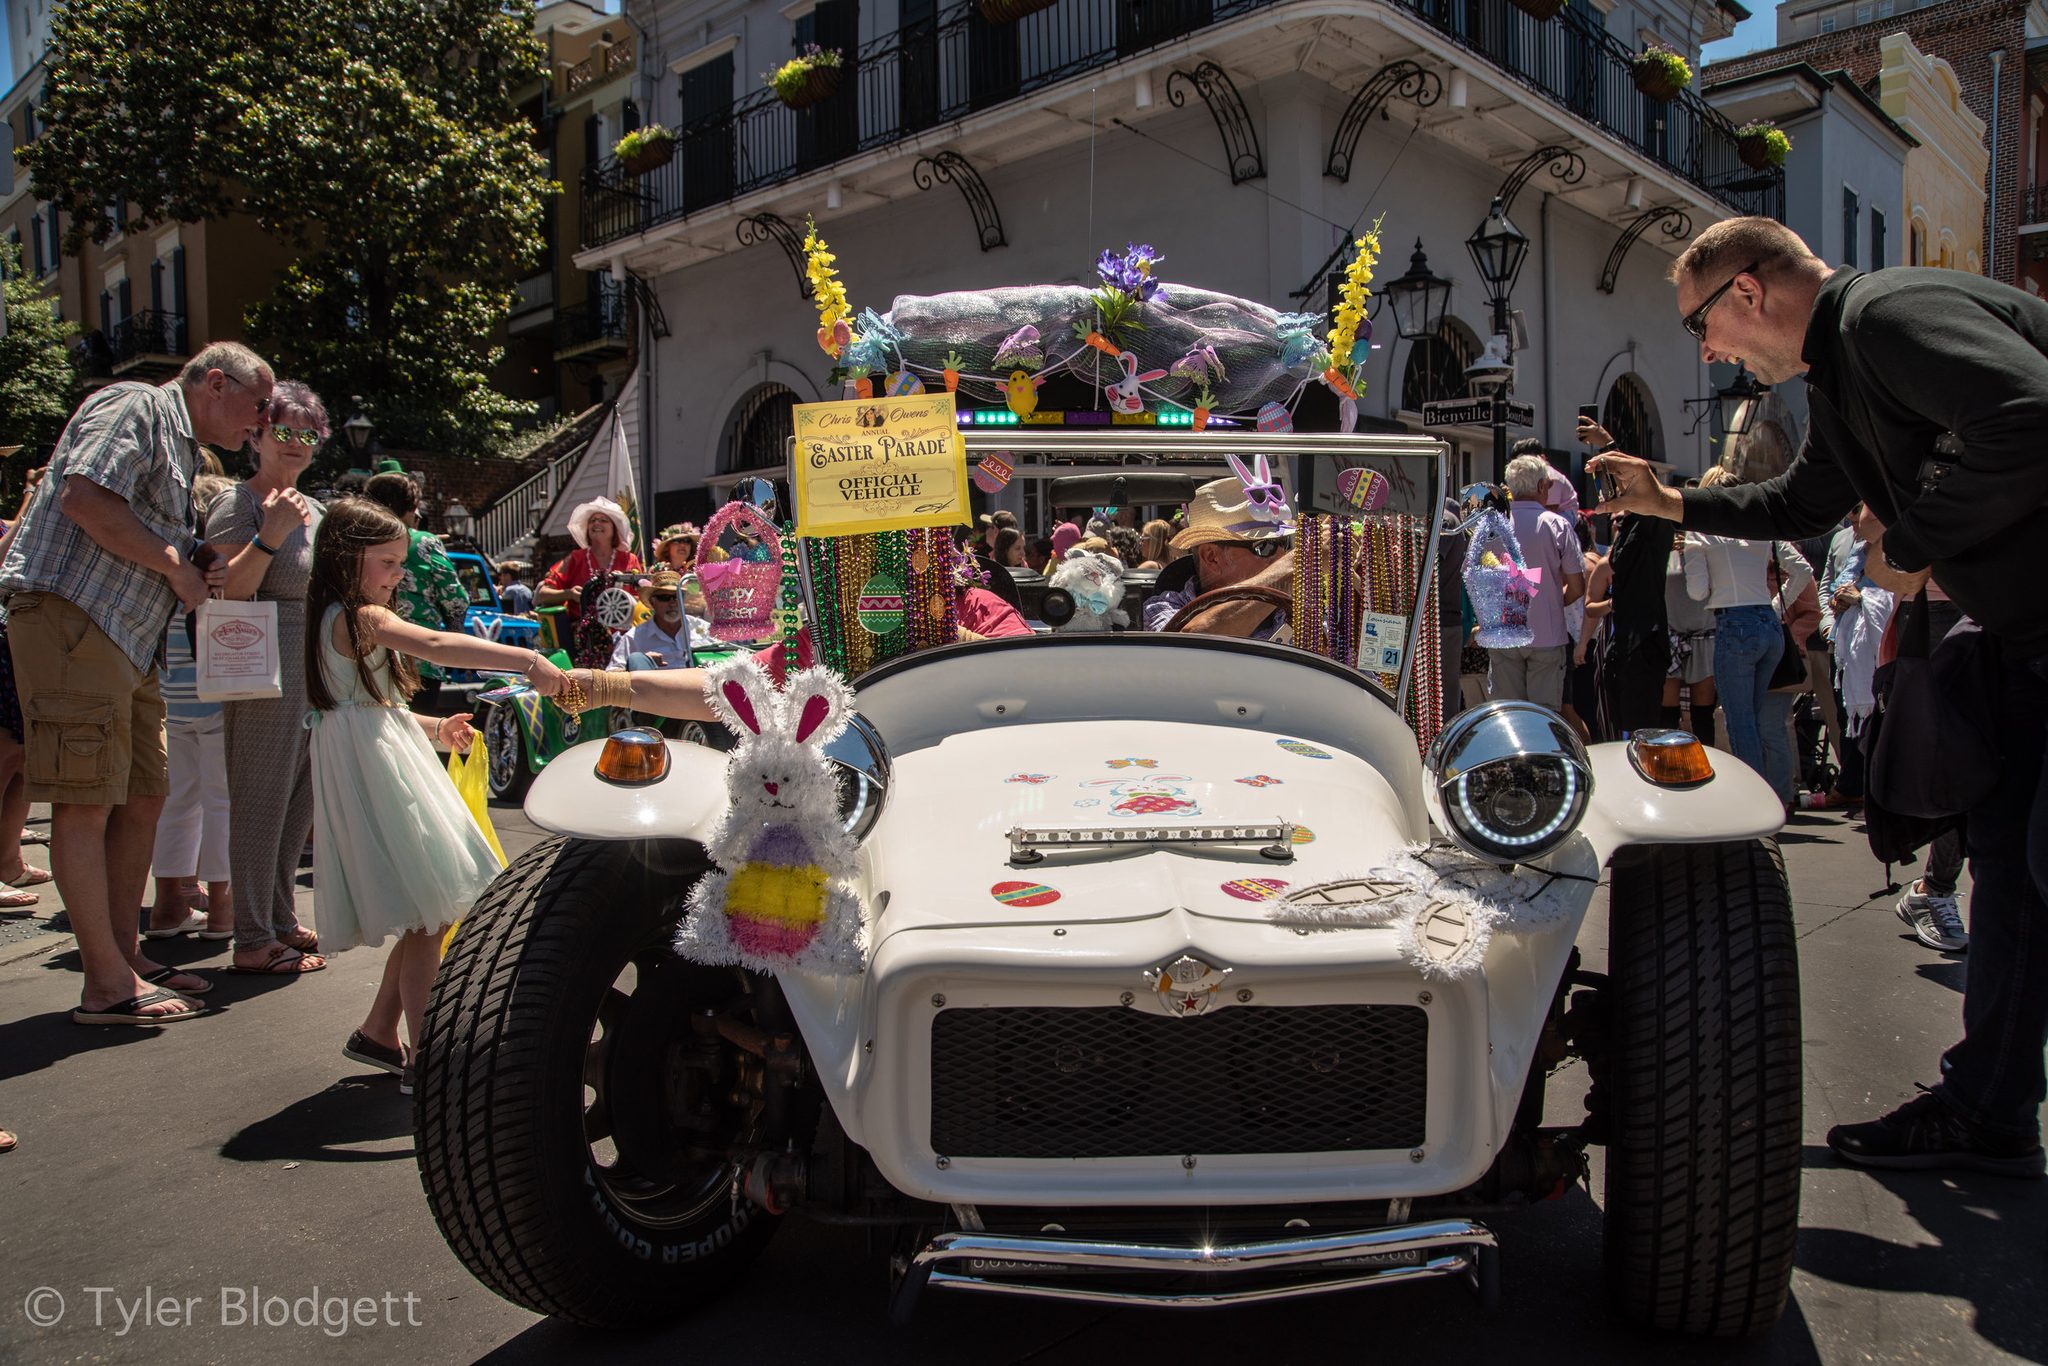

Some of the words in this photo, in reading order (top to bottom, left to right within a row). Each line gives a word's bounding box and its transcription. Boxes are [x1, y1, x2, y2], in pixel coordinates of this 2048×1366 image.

[818, 412, 852, 428] Chris
[889, 407, 929, 423] Owens
[1426, 407, 1489, 424] Bienville
[861, 428, 889, 437] ANNUAL
[811, 442, 874, 469] EASTER
[878, 435, 947, 465] PARADE
[838, 473, 923, 490] OFFICIAL
[840, 484, 922, 501] VEHICLE
[1385, 650, 1399, 665] 21
[662, 1200, 752, 1264] OOPER
